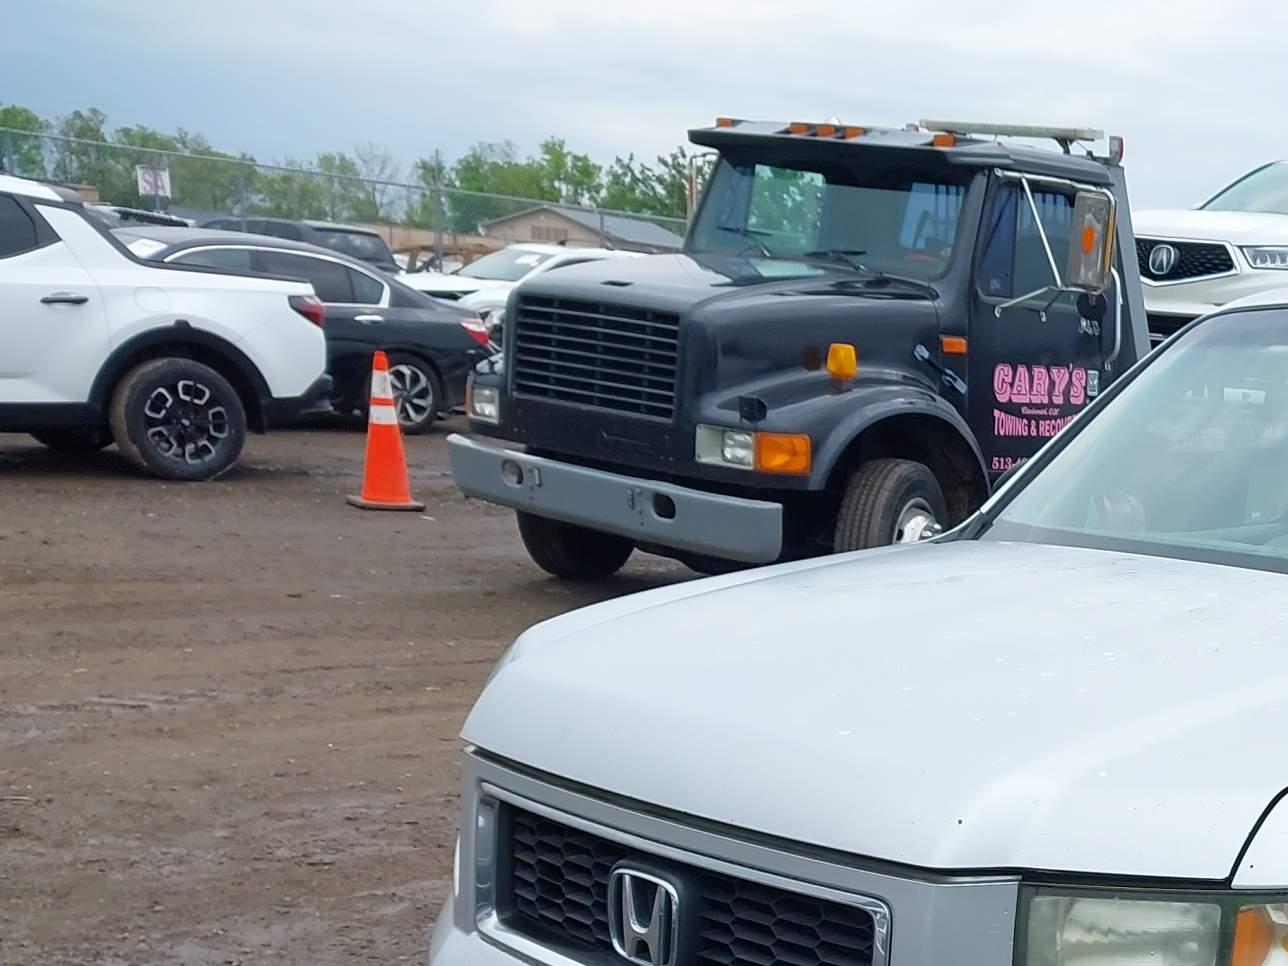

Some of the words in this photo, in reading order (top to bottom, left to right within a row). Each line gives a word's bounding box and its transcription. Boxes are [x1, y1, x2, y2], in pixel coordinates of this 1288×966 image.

[993, 362, 1086, 405] CARY'S
[993, 408, 1029, 436] TOWING
[1030, 419, 1037, 437] &
